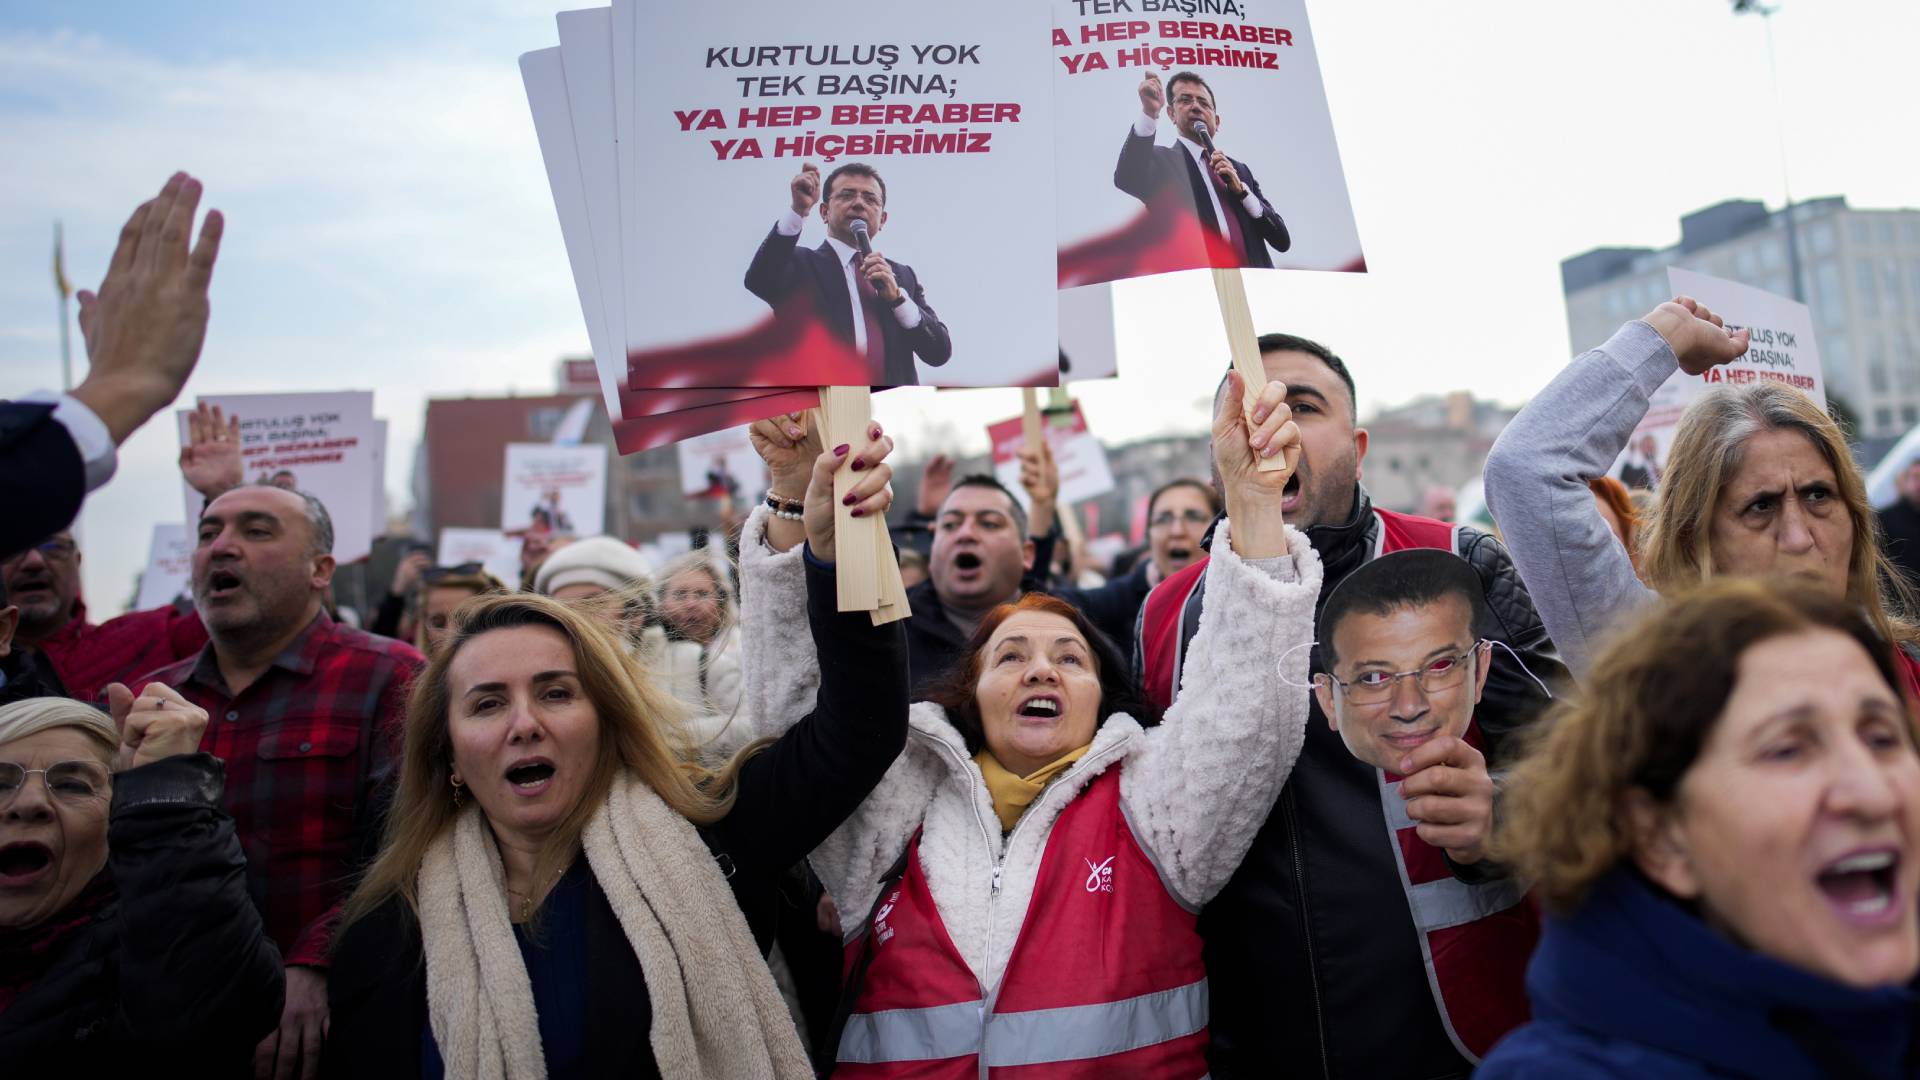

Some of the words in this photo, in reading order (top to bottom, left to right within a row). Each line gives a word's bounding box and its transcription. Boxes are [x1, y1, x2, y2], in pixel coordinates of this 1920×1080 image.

[1072, 0, 1132, 16] TEK
[1142, 0, 1246, 20] BAŞINA;
[1052, 28, 1072, 46] A
[1080, 21, 1151, 44] HEP
[1158, 20, 1293, 46] BERABER
[705, 44, 900, 71] KURTULUŞ
[911, 44, 981, 65] YOK
[1060, 52, 1109, 75] YA
[1117, 43, 1280, 71] HİÇBİRİMİZ
[736, 75, 806, 98] TEK
[816, 74, 957, 101] BAŞINA;
[674, 109, 727, 132] YA
[737, 105, 822, 129] HEP
[830, 103, 1022, 126] BERABER
[709, 137, 764, 161] YA
[773, 127, 993, 163] HİÇBİRİMİZ
[1775, 331, 1798, 347] YOK
[1751, 348, 1796, 369] BAŞINA;
[1726, 368, 1756, 384] HEP
